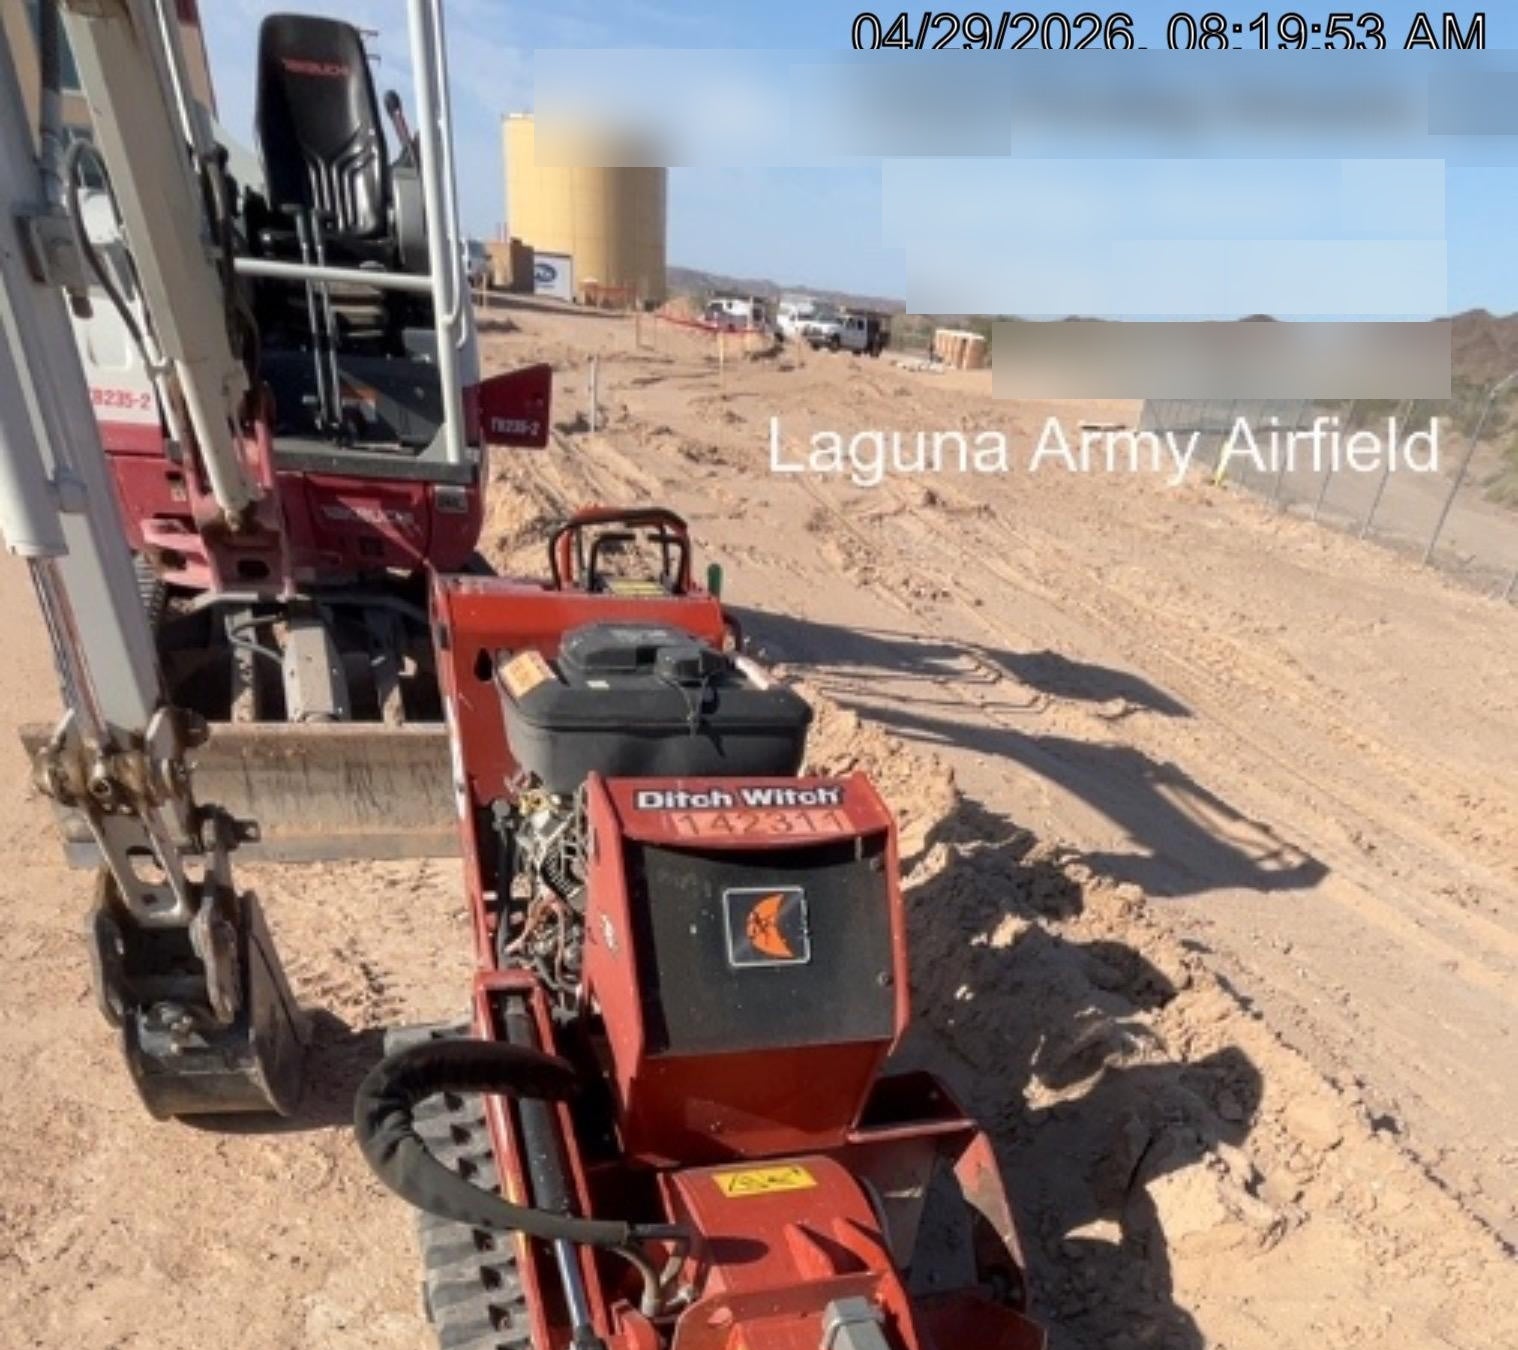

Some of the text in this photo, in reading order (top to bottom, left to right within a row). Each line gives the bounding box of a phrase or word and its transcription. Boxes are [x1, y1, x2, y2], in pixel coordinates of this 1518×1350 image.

[88, 386, 152, 411] B235-2
[637, 786, 840, 809] Ditch Witch
[678, 811, 846, 836] 142311
